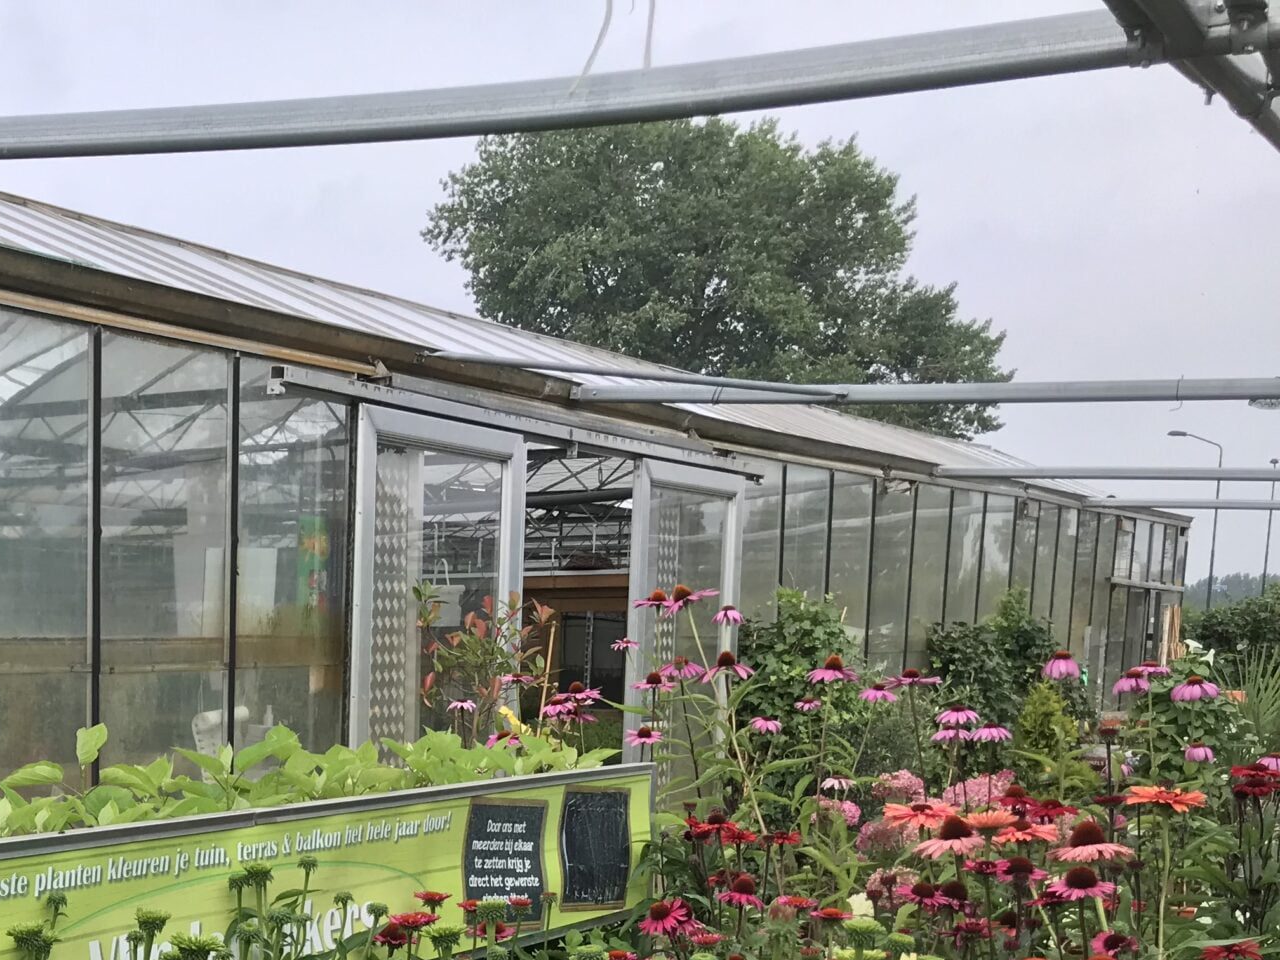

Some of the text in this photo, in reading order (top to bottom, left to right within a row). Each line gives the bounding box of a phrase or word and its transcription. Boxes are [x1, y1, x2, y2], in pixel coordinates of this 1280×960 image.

[486, 819, 501, 833] Door
[513, 821, 527, 833] met
[34, 865, 102, 897] planten
[107, 855, 170, 882] kleuren
[174, 848, 189, 876] je
[194, 843, 231, 868] tuin,
[236, 840, 277, 862] terras
[282, 834, 291, 853] &
[295, 829, 341, 852] balkon
[344, 823, 363, 844] het
[366, 819, 391, 841] hele
[393, 818, 421, 842] jaar
[423, 811, 452, 833] door!
[474, 856, 483, 869] te
[483, 856, 507, 869] zetten
[524, 857, 532, 873] je
[468, 874, 490, 887] direct
[490, 874, 504, 887] het
